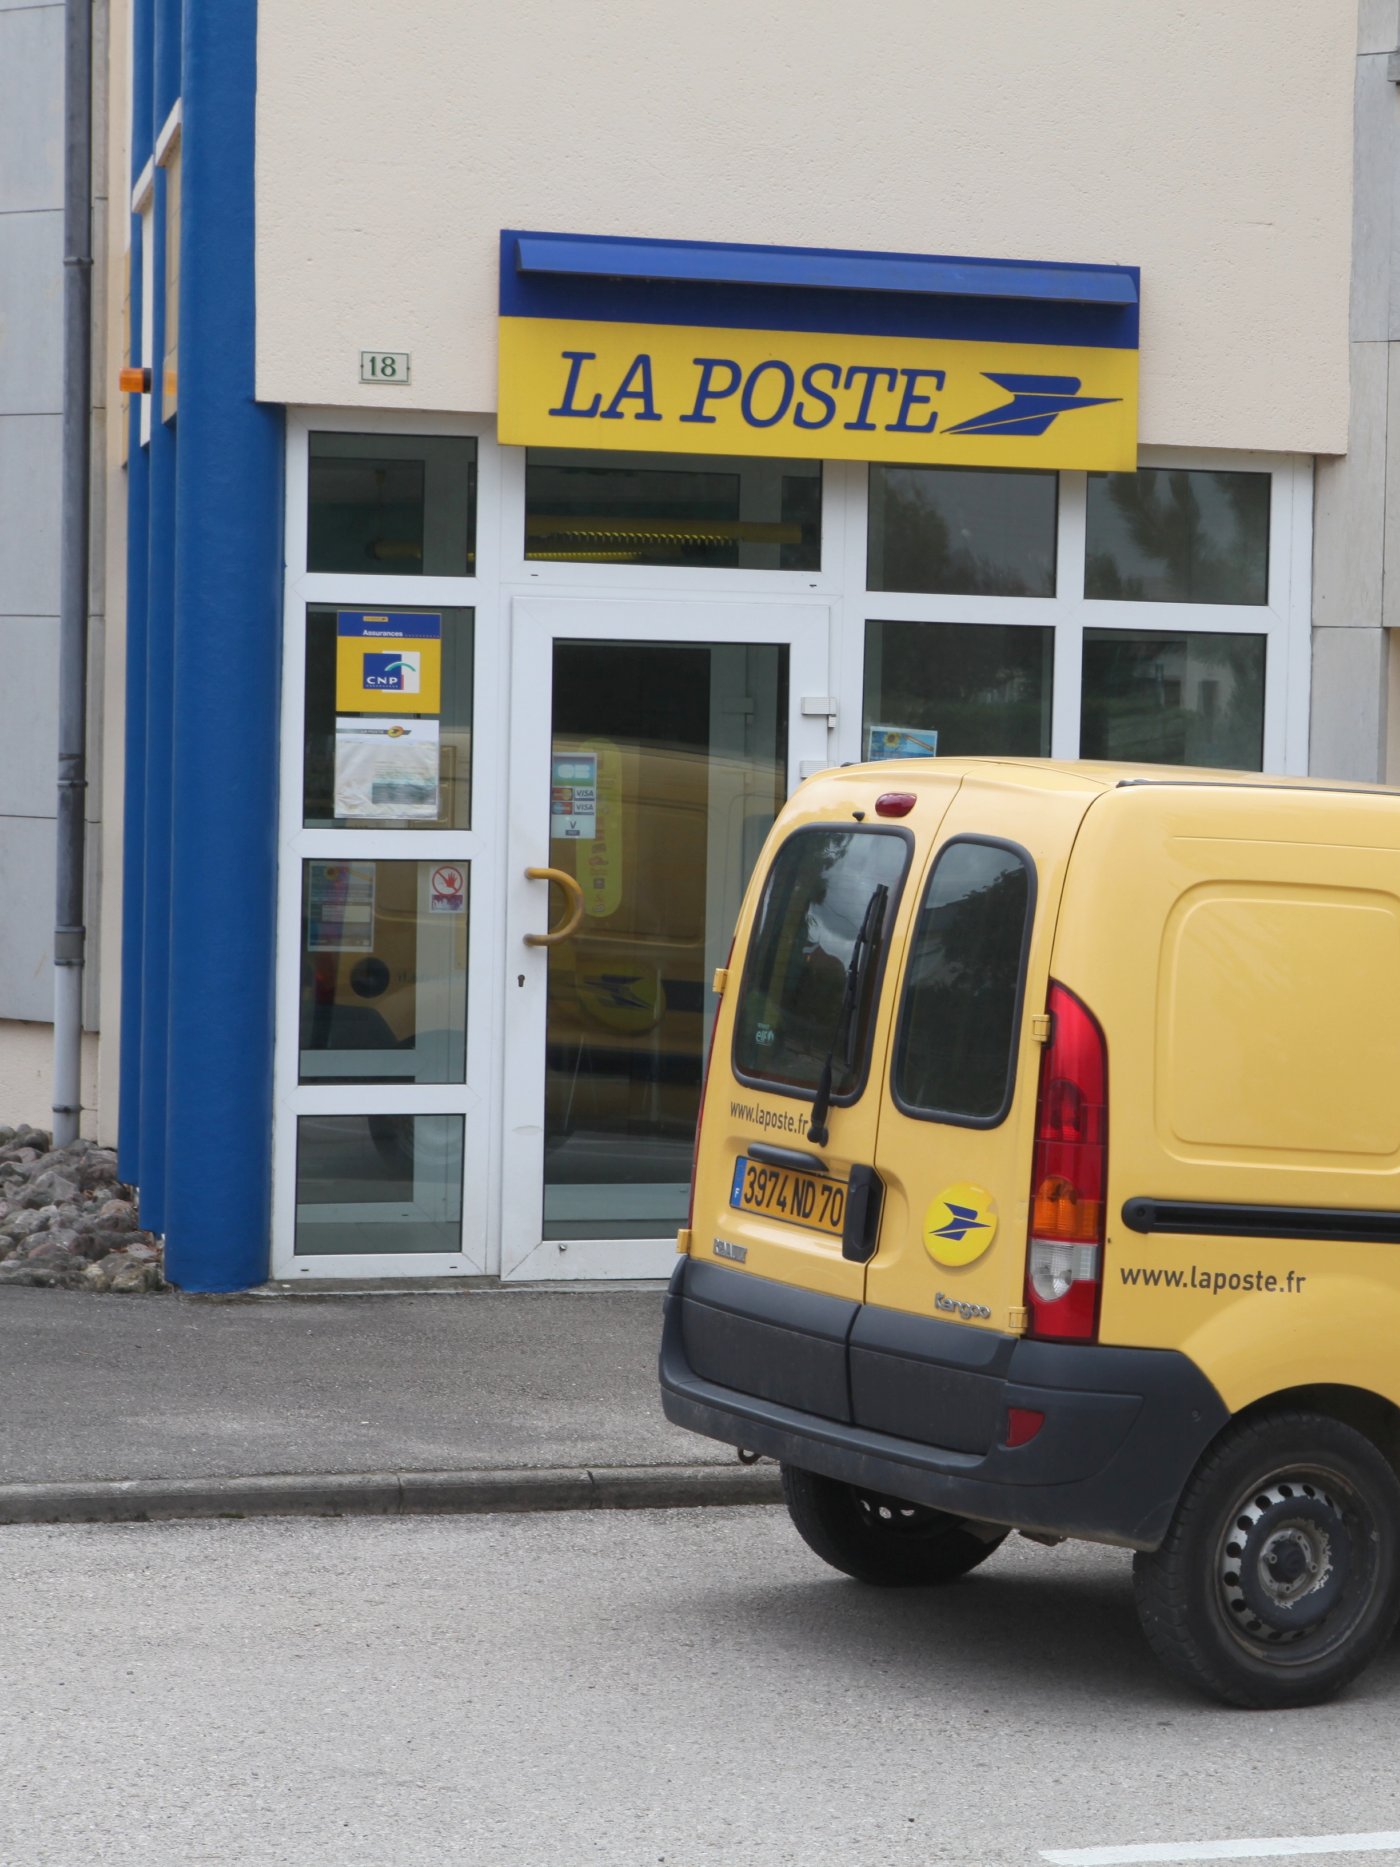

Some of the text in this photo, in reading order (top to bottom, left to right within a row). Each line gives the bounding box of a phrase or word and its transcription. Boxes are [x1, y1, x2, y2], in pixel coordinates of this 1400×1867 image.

[369, 355, 398, 379] 18
[549, 351, 945, 434] LA POSTE
[363, 629, 404, 638] Assurances
[366, 676, 398, 685] CNP
[576, 789, 594, 797] VISA
[576, 803, 594, 811] VISA
[730, 1101, 809, 1136] www.laposte.fr
[744, 1166, 844, 1227] 3974 ND 70
[1119, 1266, 1307, 1296] www.laposte.fr
